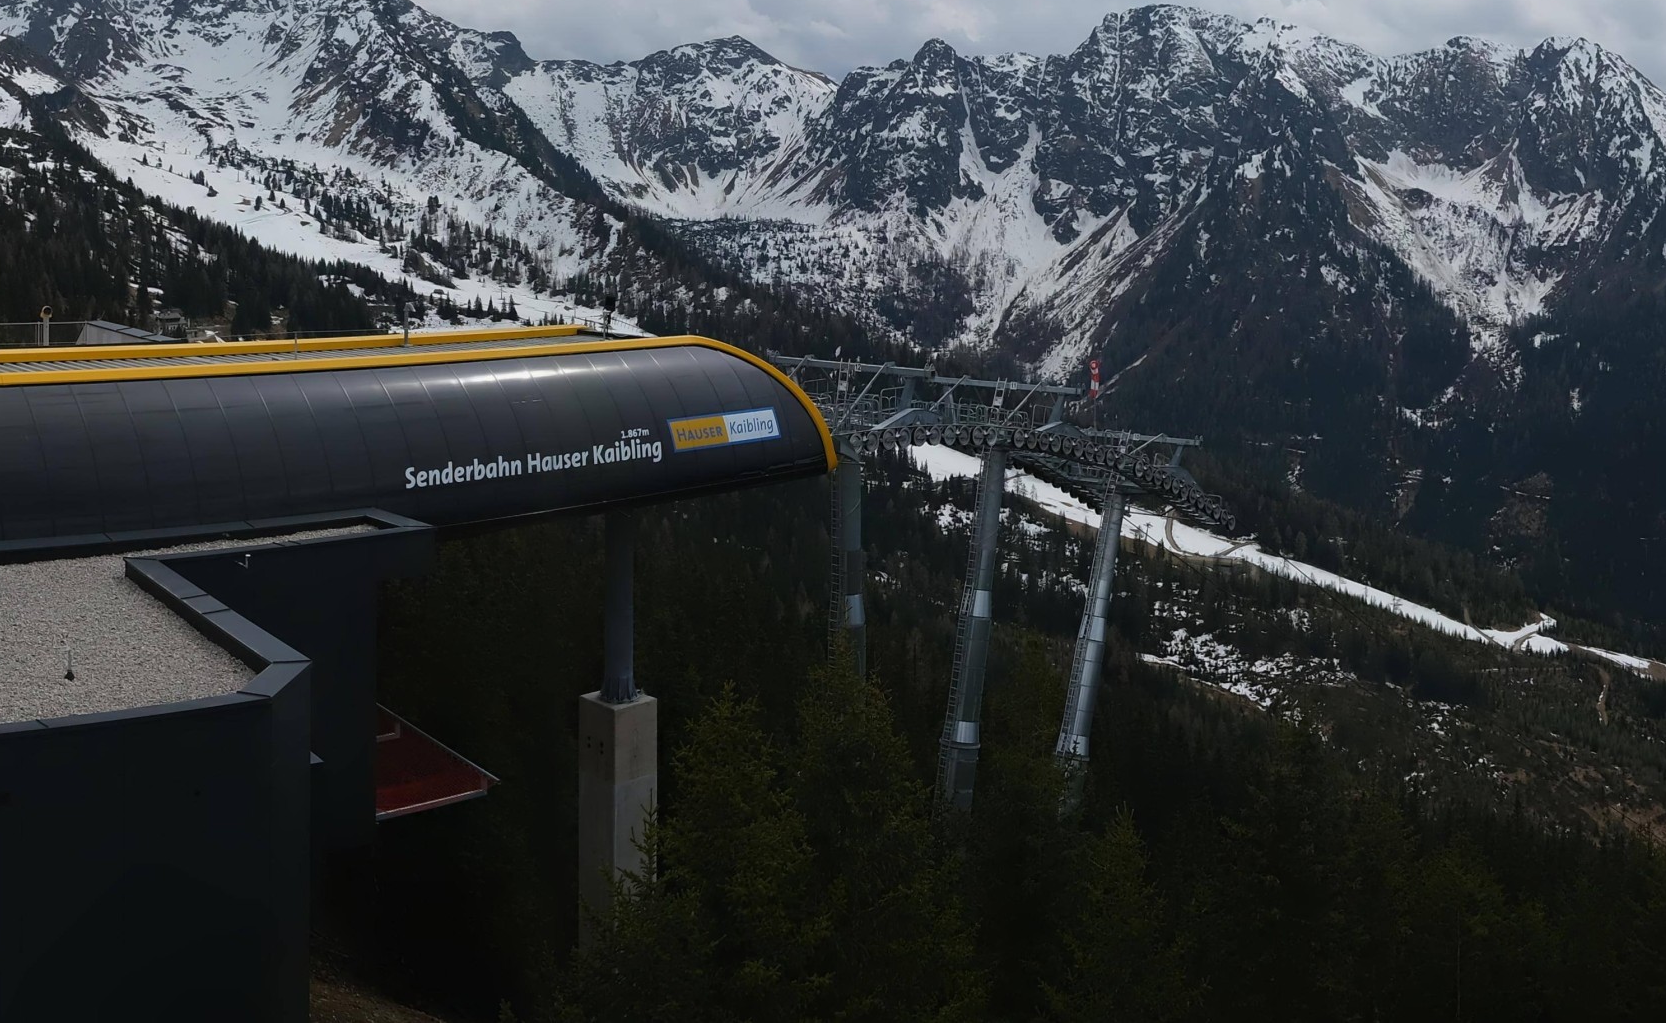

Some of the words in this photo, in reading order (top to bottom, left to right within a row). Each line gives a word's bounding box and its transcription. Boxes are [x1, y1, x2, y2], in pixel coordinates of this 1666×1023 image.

[620, 427, 650, 439] 1.867m
[729, 417, 774, 435] Kaibling
[405, 456, 522, 489] Senderbahn
[527, 451, 589, 473] Hauser
[592, 438, 662, 464] Kaibling
